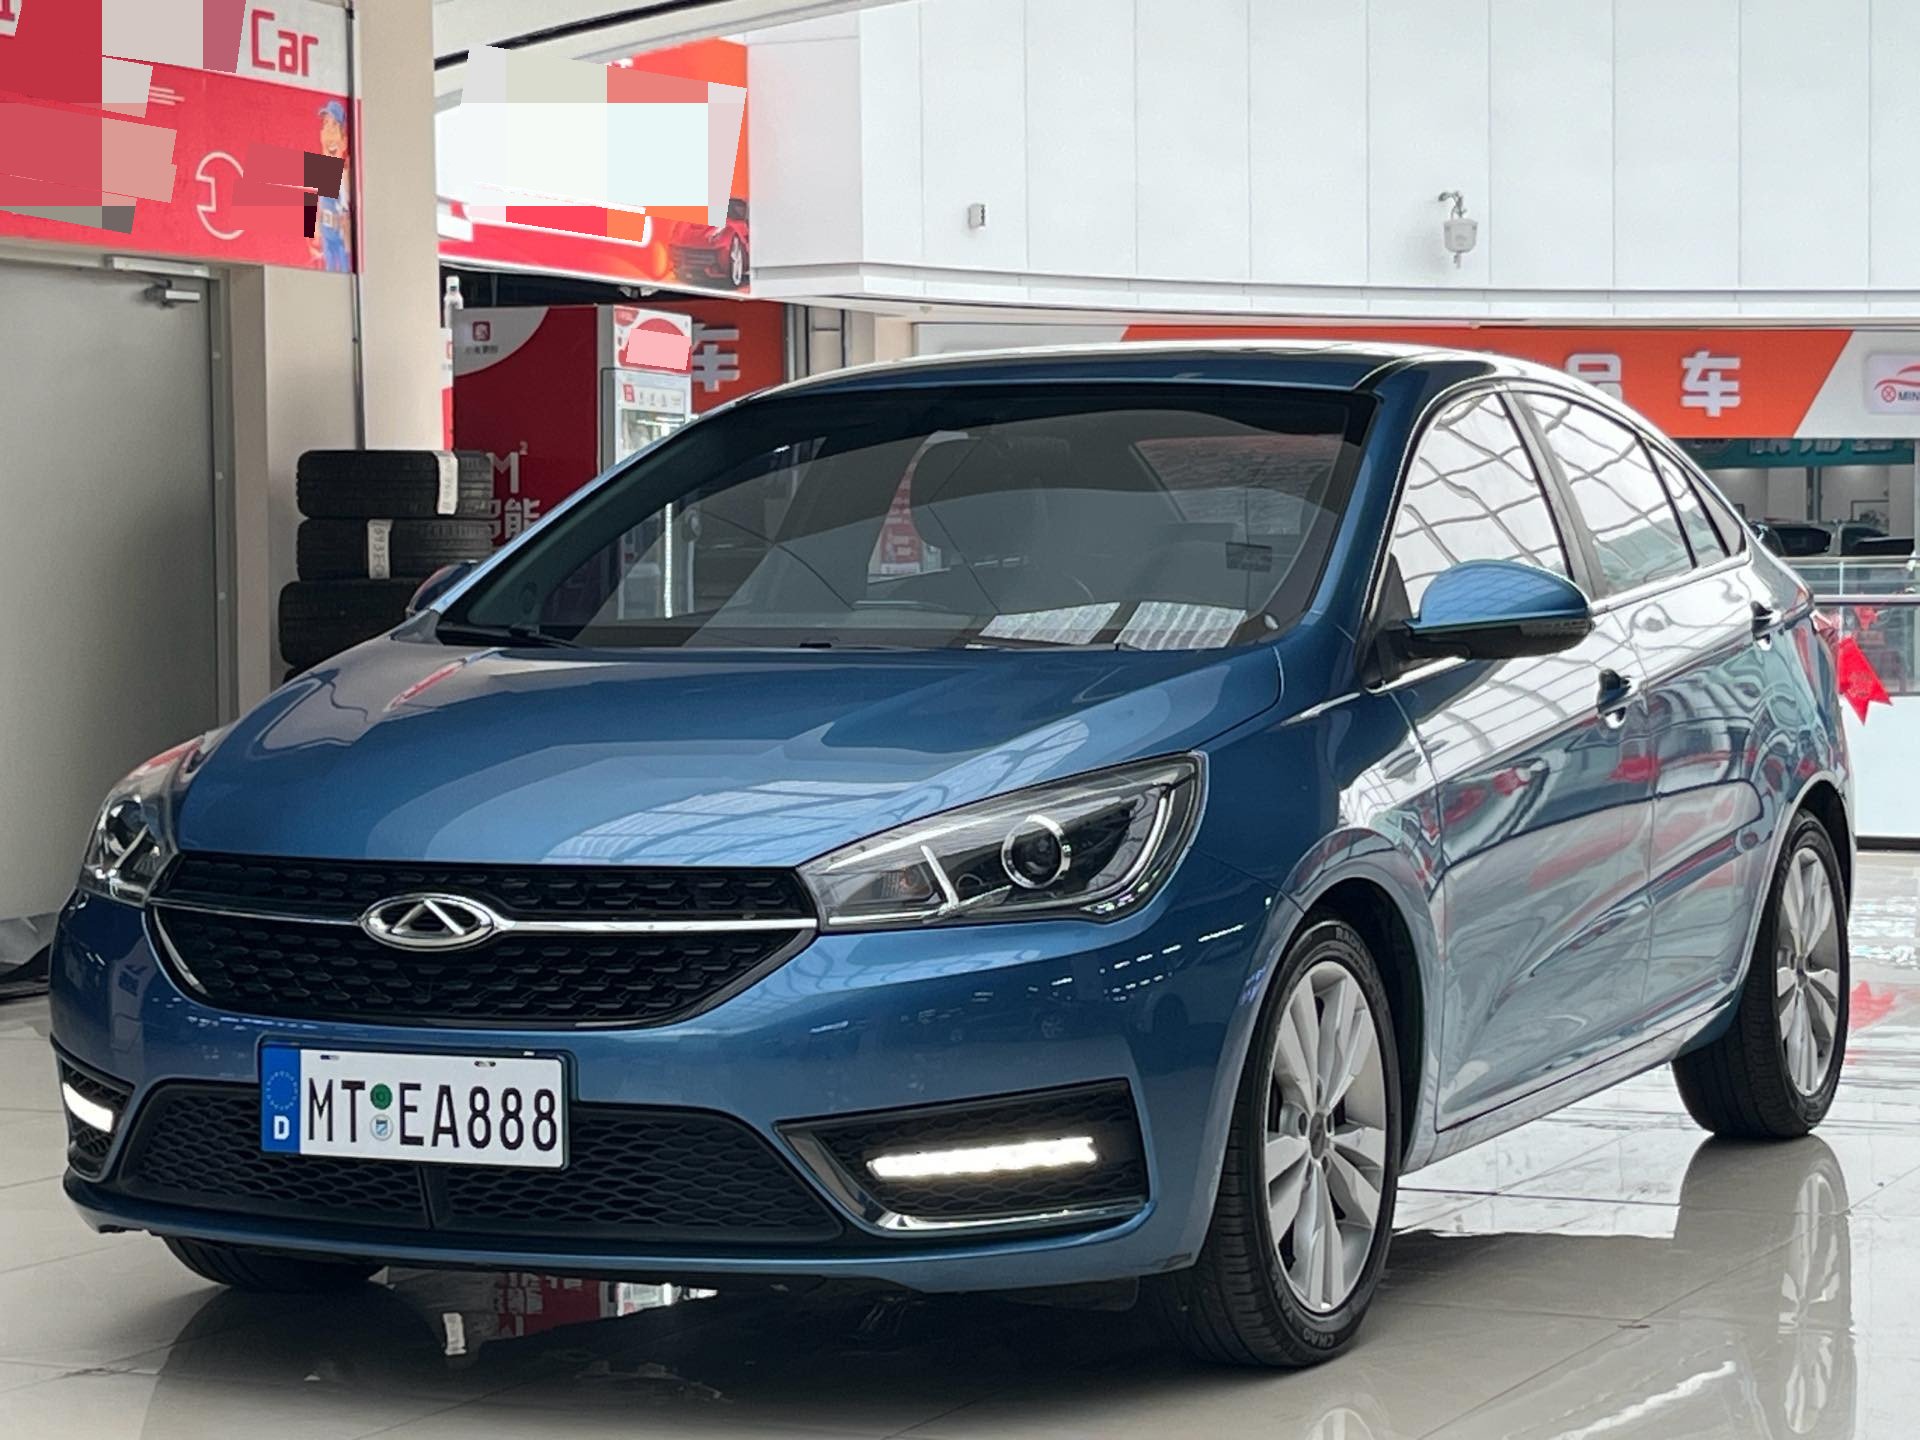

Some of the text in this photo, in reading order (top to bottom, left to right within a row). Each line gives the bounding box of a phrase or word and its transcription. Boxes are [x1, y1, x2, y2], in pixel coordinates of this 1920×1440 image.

[252, 9, 319, 77] Car
[273, 1115, 290, 1140] D
[308, 1077, 557, 1152] MT EA888
